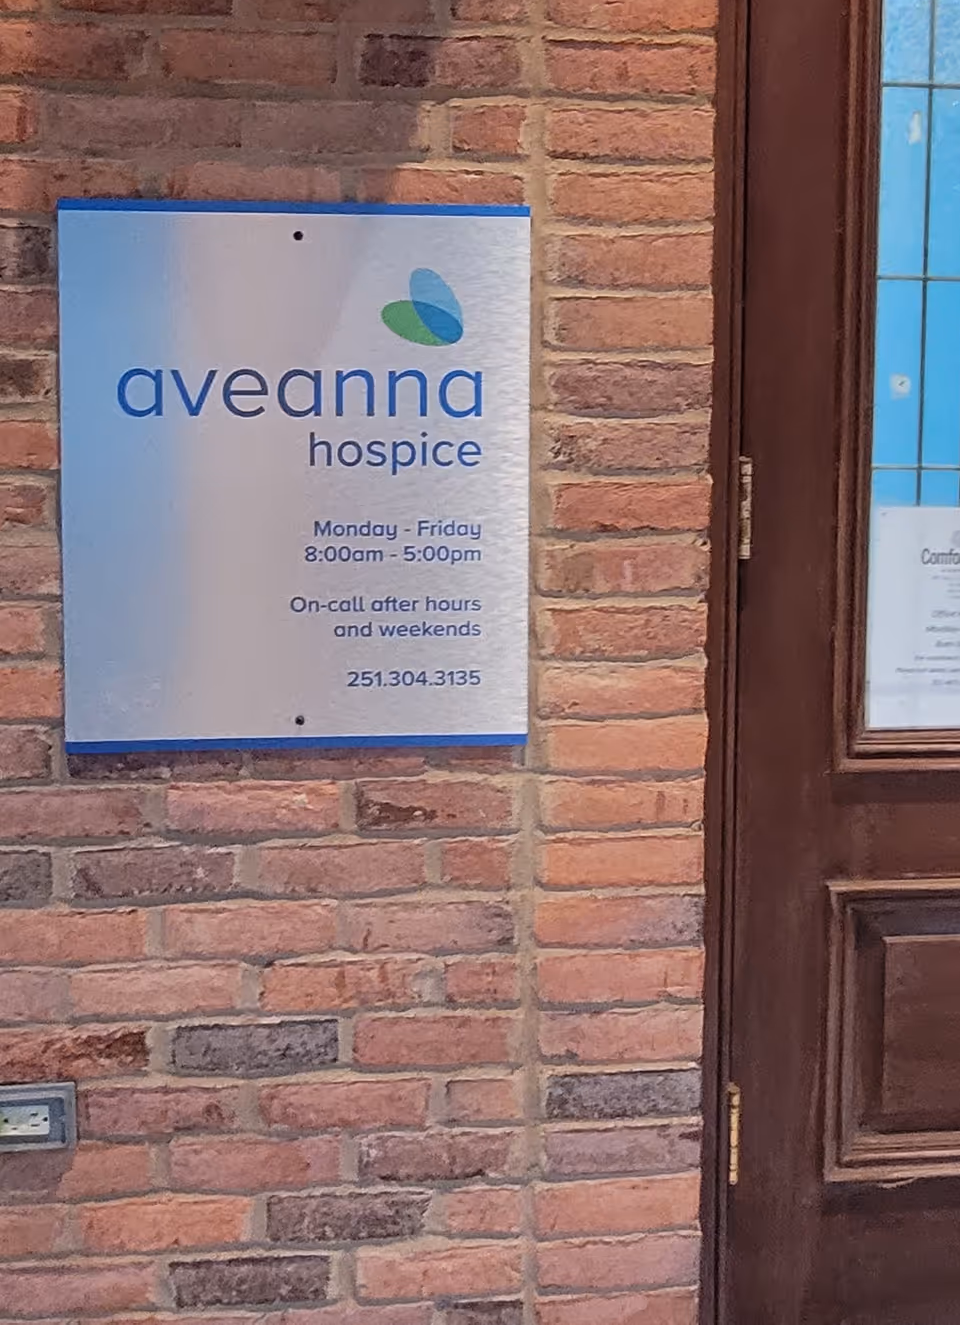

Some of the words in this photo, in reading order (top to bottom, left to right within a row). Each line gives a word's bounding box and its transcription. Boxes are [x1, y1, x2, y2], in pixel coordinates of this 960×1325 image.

[116, 367, 483, 418] aveanna
[308, 431, 482, 475] hospice
[313, 520, 398, 541] Monday
[417, 519, 482, 540] Friday
[304, 546, 384, 562] 8:00am
[403, 545, 482, 564] 5:00pm
[289, 596, 366, 613] On-call
[370, 595, 419, 612] after
[425, 595, 482, 612] hours
[333, 621, 373, 637] and
[378, 620, 482, 637] weekends
[346, 669, 482, 687] 251.304.3135
